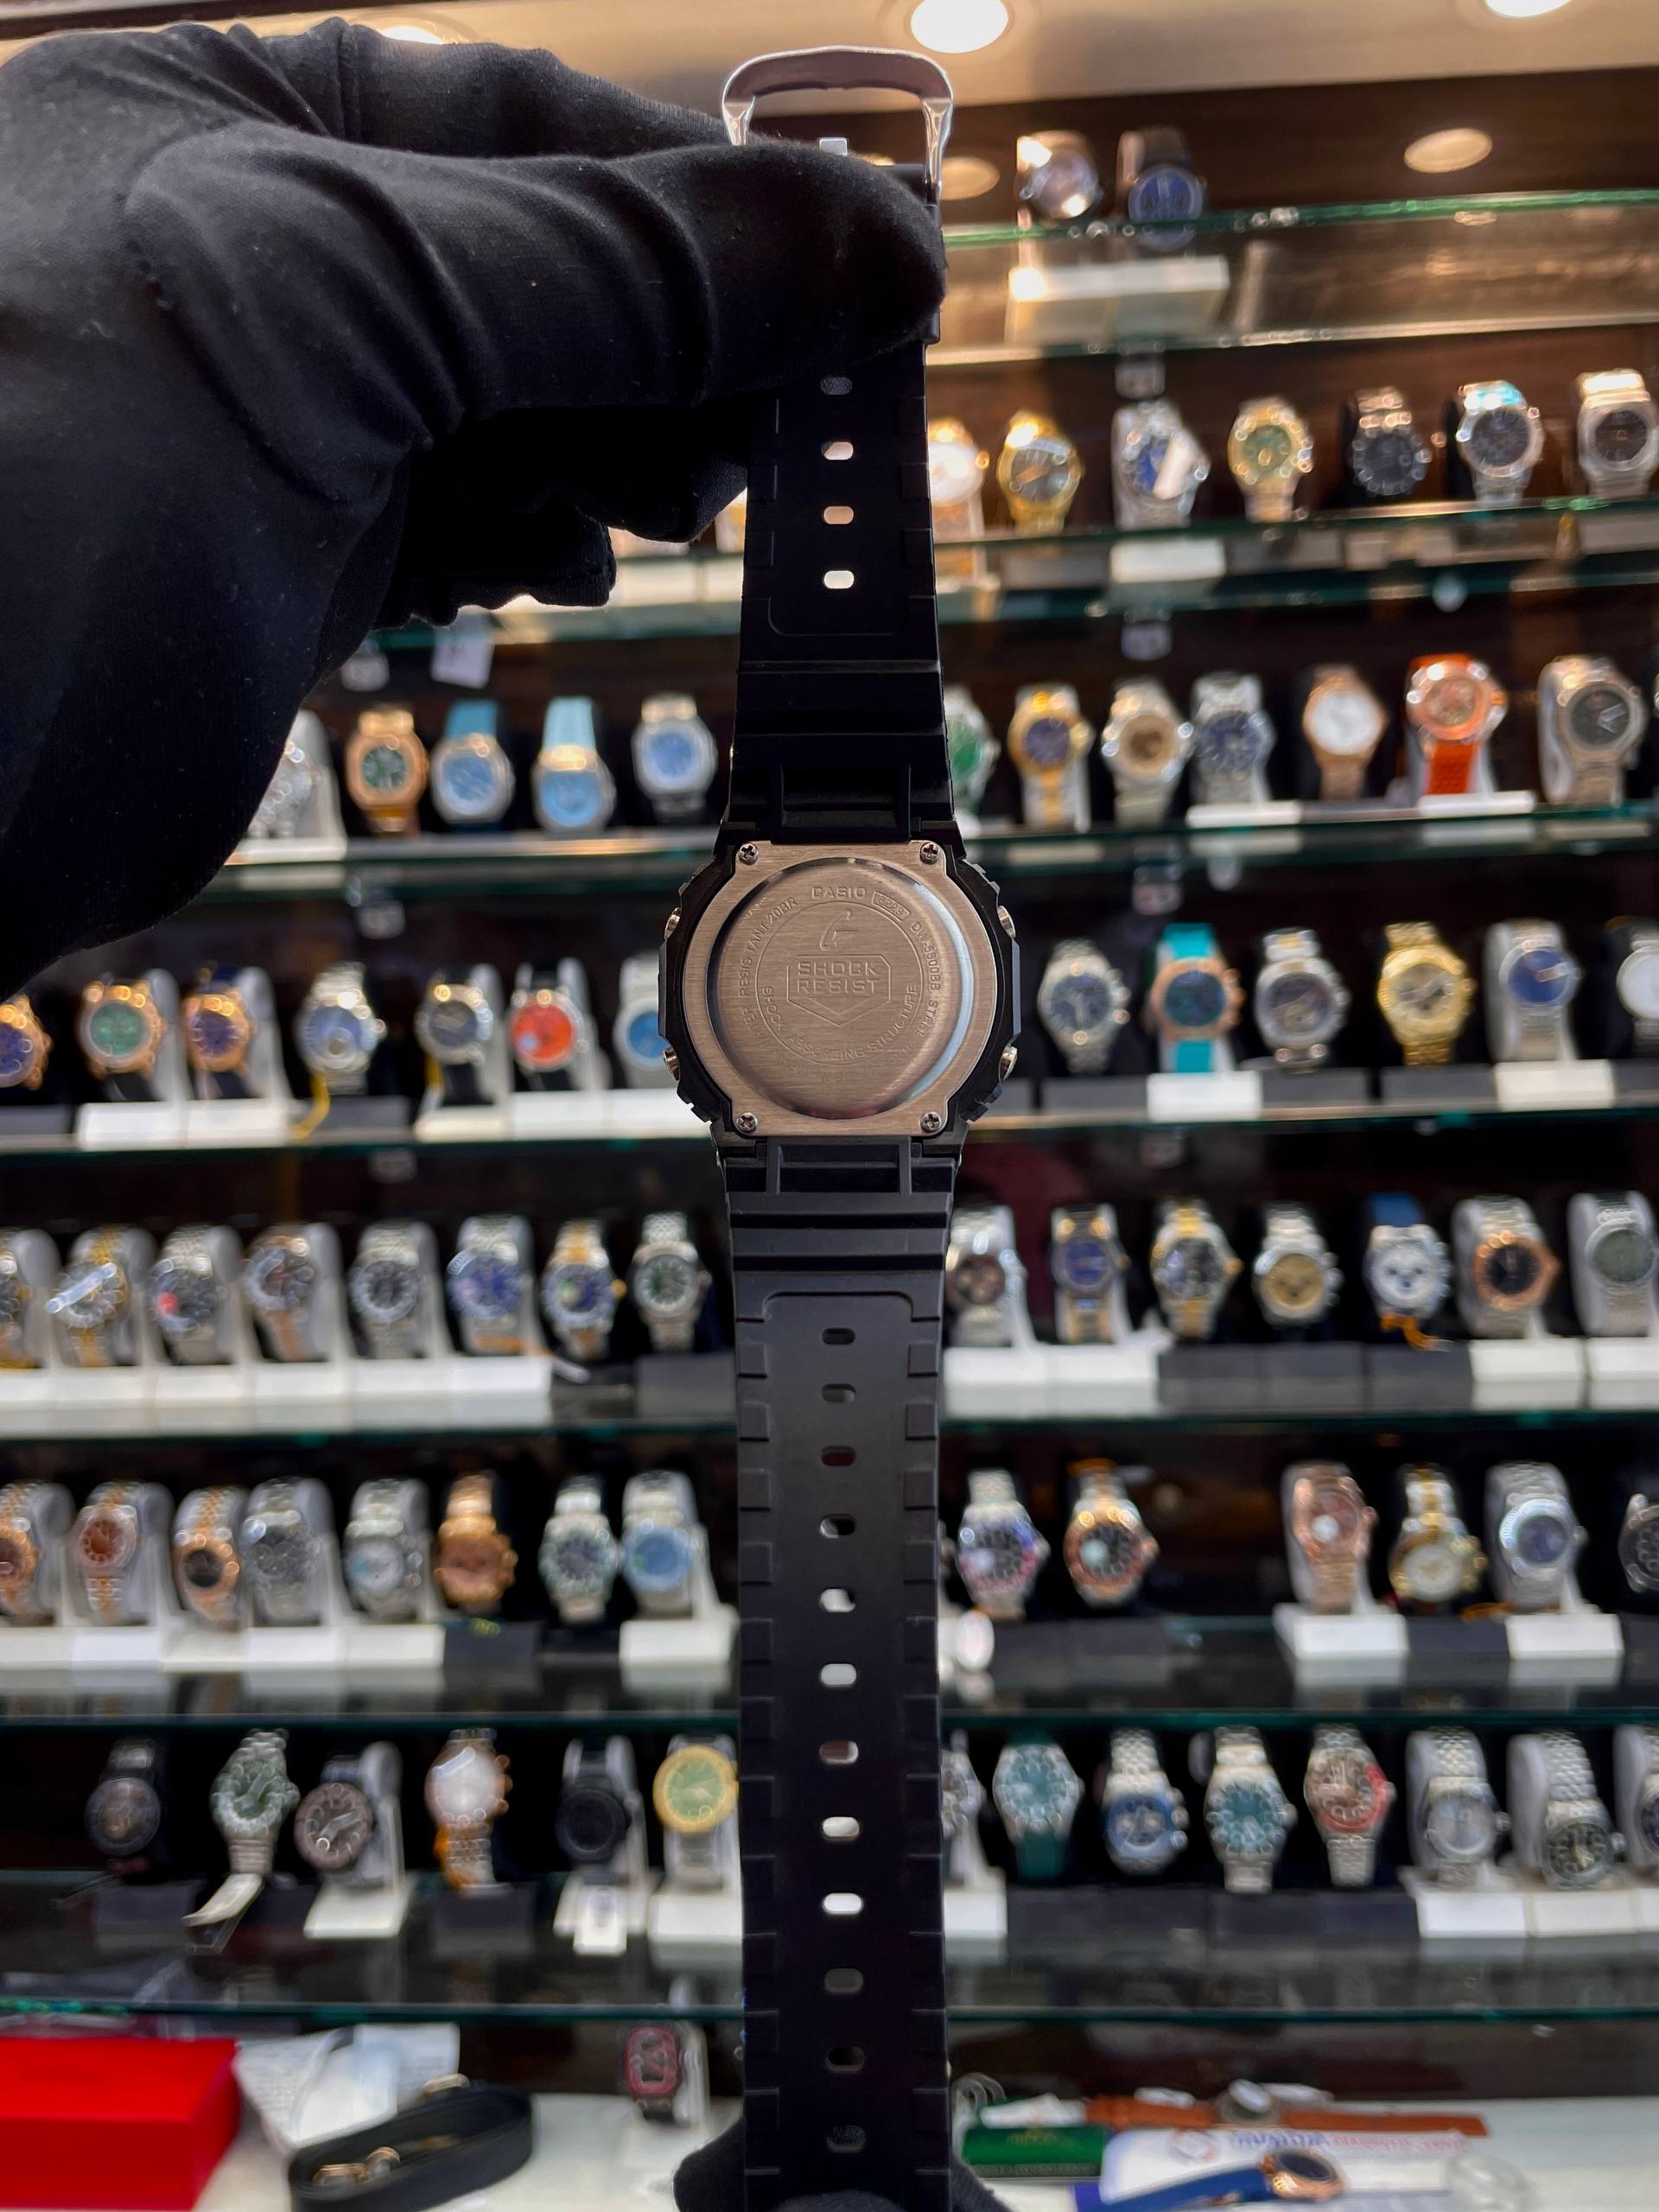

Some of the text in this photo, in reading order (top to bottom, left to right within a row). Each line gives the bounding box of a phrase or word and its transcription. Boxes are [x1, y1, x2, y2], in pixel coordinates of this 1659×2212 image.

[812, 886, 866, 899] CASIO
[798, 960, 880, 976] SHOCK
[797, 978, 880, 995] RESIST
